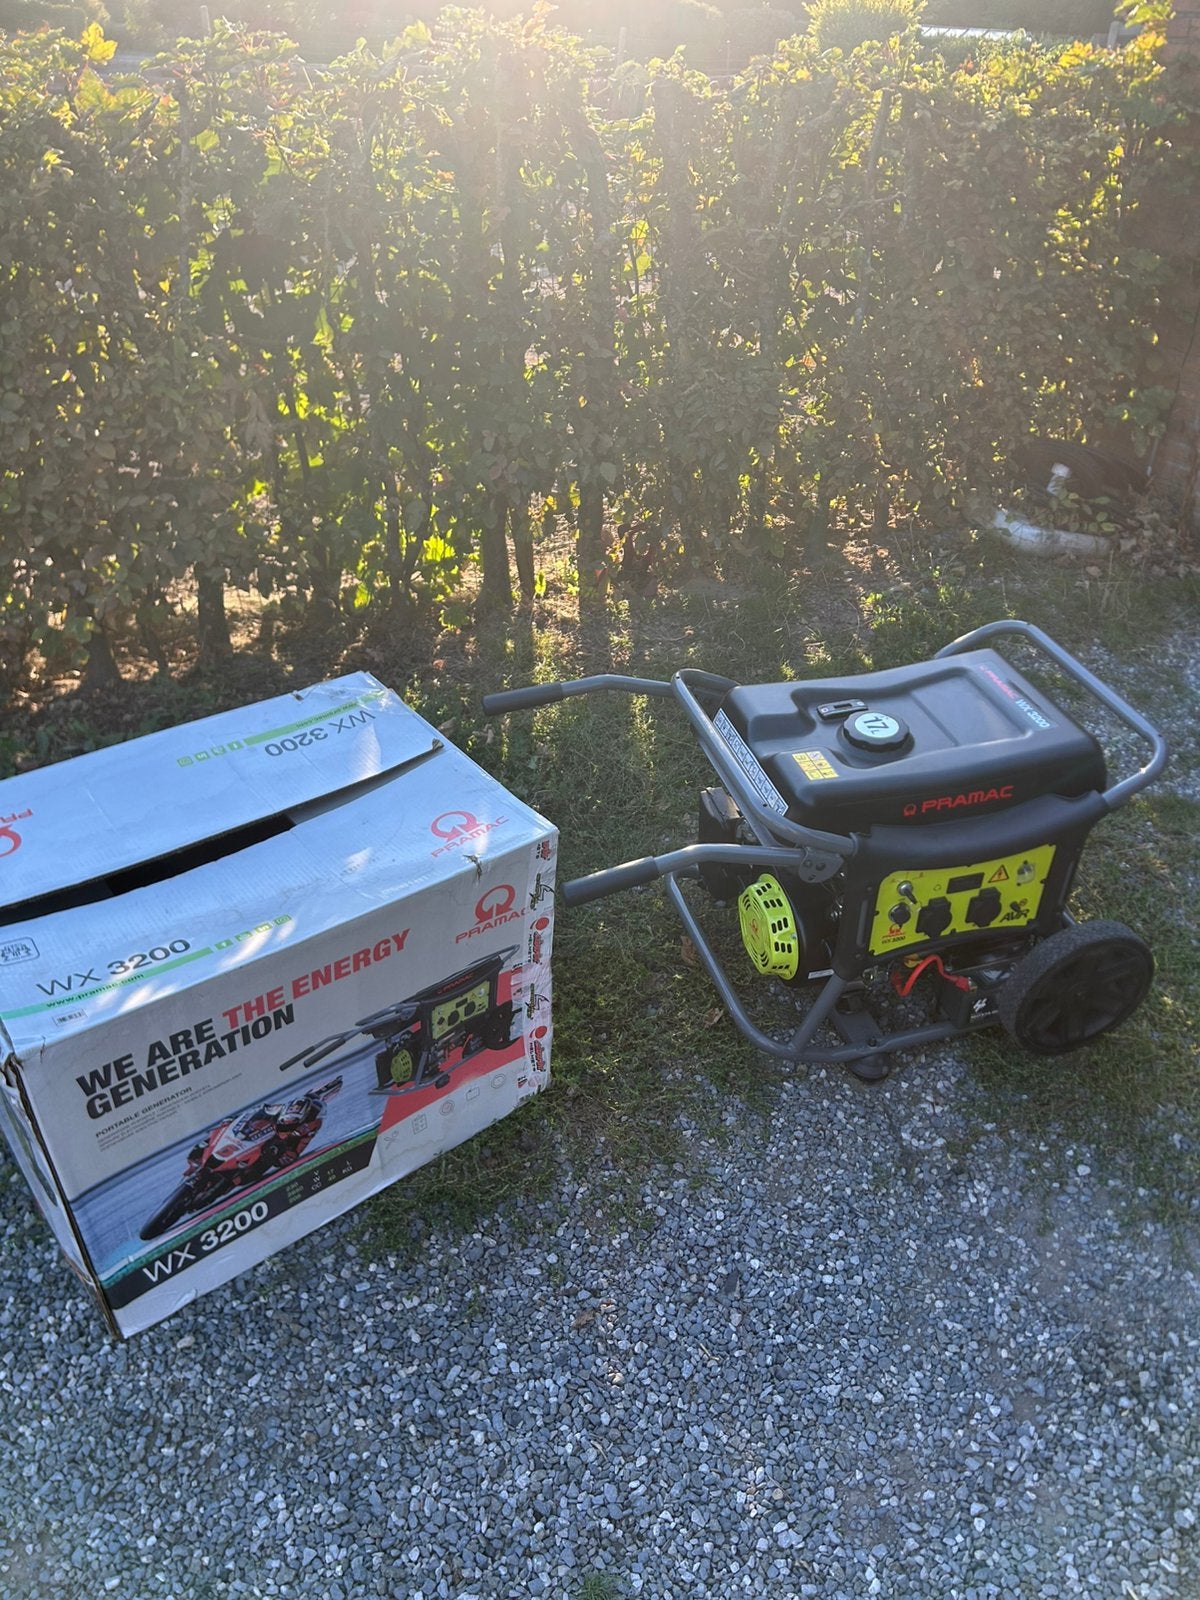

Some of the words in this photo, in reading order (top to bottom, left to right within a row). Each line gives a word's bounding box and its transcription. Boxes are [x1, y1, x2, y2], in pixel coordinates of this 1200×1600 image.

[264, 728, 328, 757] 3200
[329, 710, 376, 734] WX
[921, 785, 1014, 813] PRAMAC
[431, 815, 509, 858] PRAMAC
[36, 968, 102, 996] WX
[107, 939, 191, 976] 3200
[75, 1053, 138, 1097] WE
[147, 1018, 216, 1068] ARE
[222, 986, 286, 1030] THE
[292, 928, 411, 1000] ENERGY
[86, 1003, 295, 1121] GENERATION
[96, 1111, 139, 1138] PORTABLE
[142, 1087, 192, 1114] GENERATOR
[143, 1242, 197, 1283] WX
[200, 1201, 269, 1251] 3200
